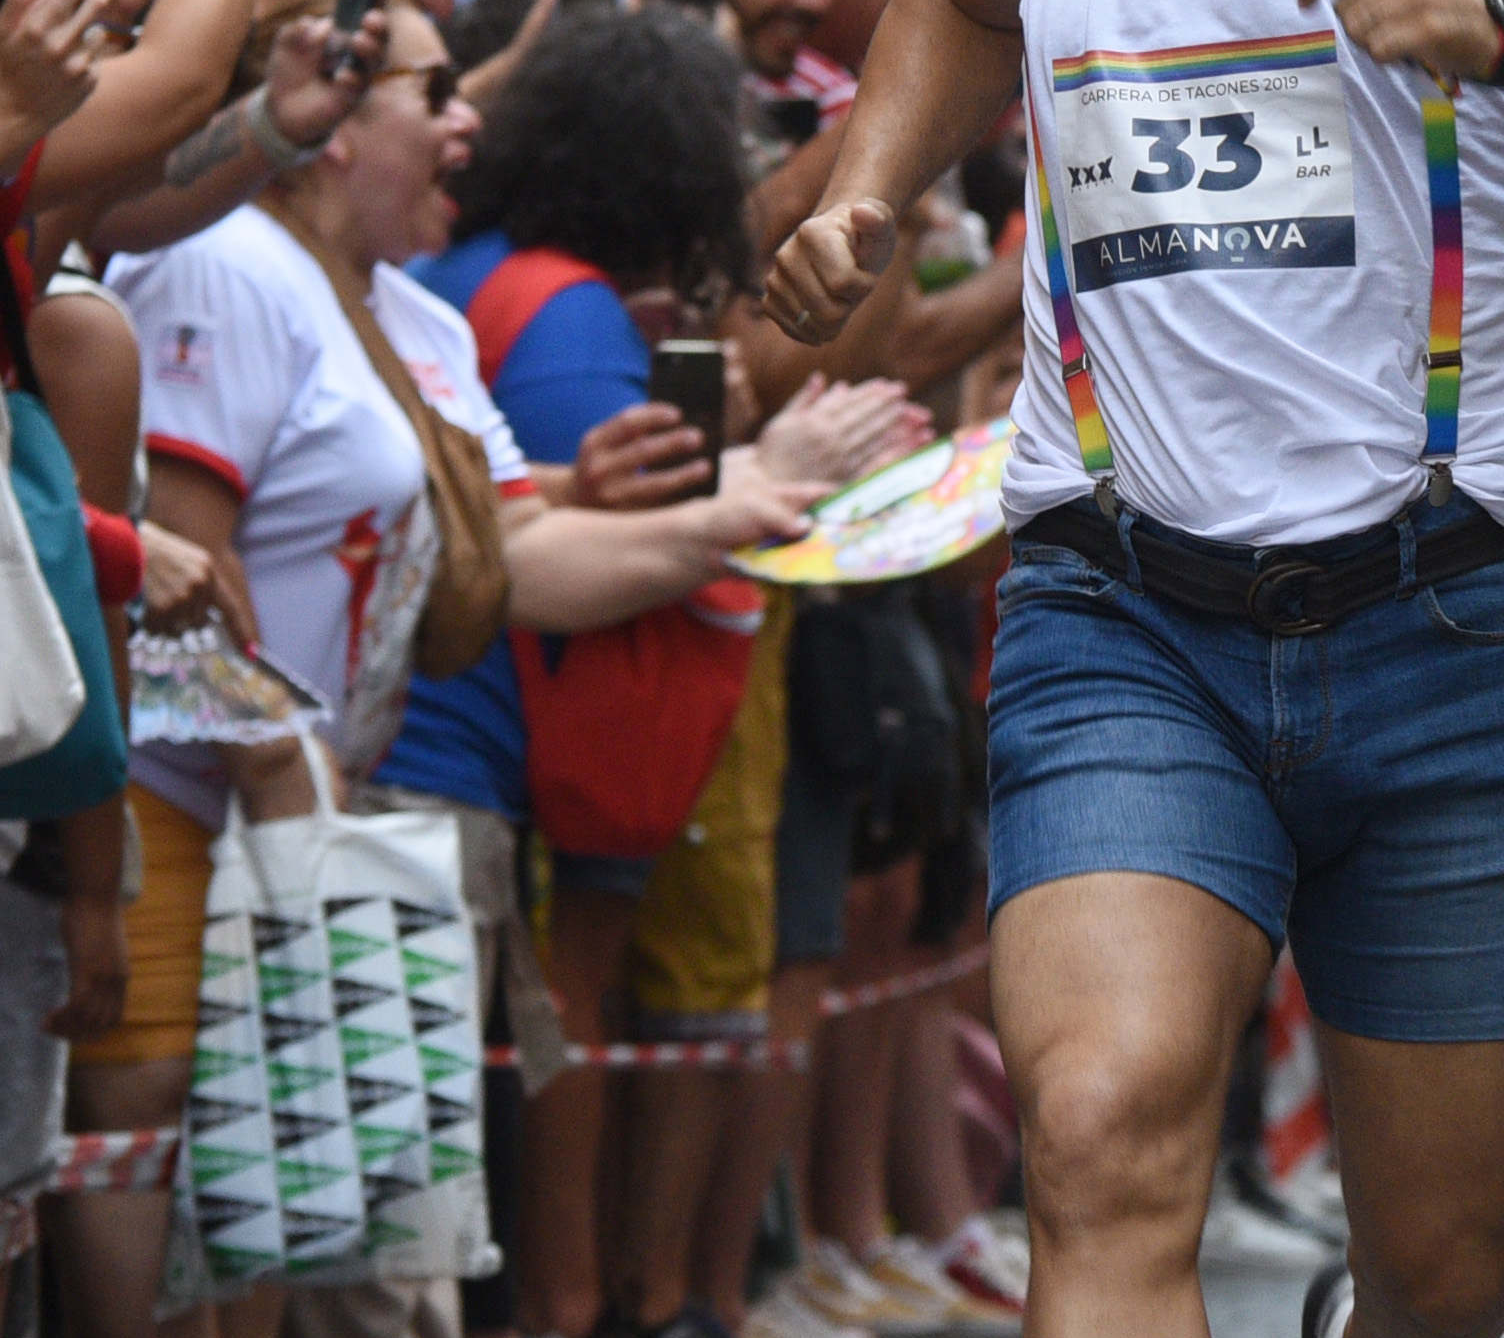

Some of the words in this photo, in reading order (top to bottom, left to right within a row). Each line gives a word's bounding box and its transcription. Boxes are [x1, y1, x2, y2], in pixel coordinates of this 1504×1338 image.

[1081, 88, 1153, 106] CARRERA
[1157, 88, 1181, 103] DE
[1184, 79, 1261, 99] TACONES
[1263, 75, 1299, 93] 2019
[1130, 111, 1263, 194] 33
[1295, 164, 1332, 179] BAR
[1098, 221, 1308, 268] ALMANOVA
